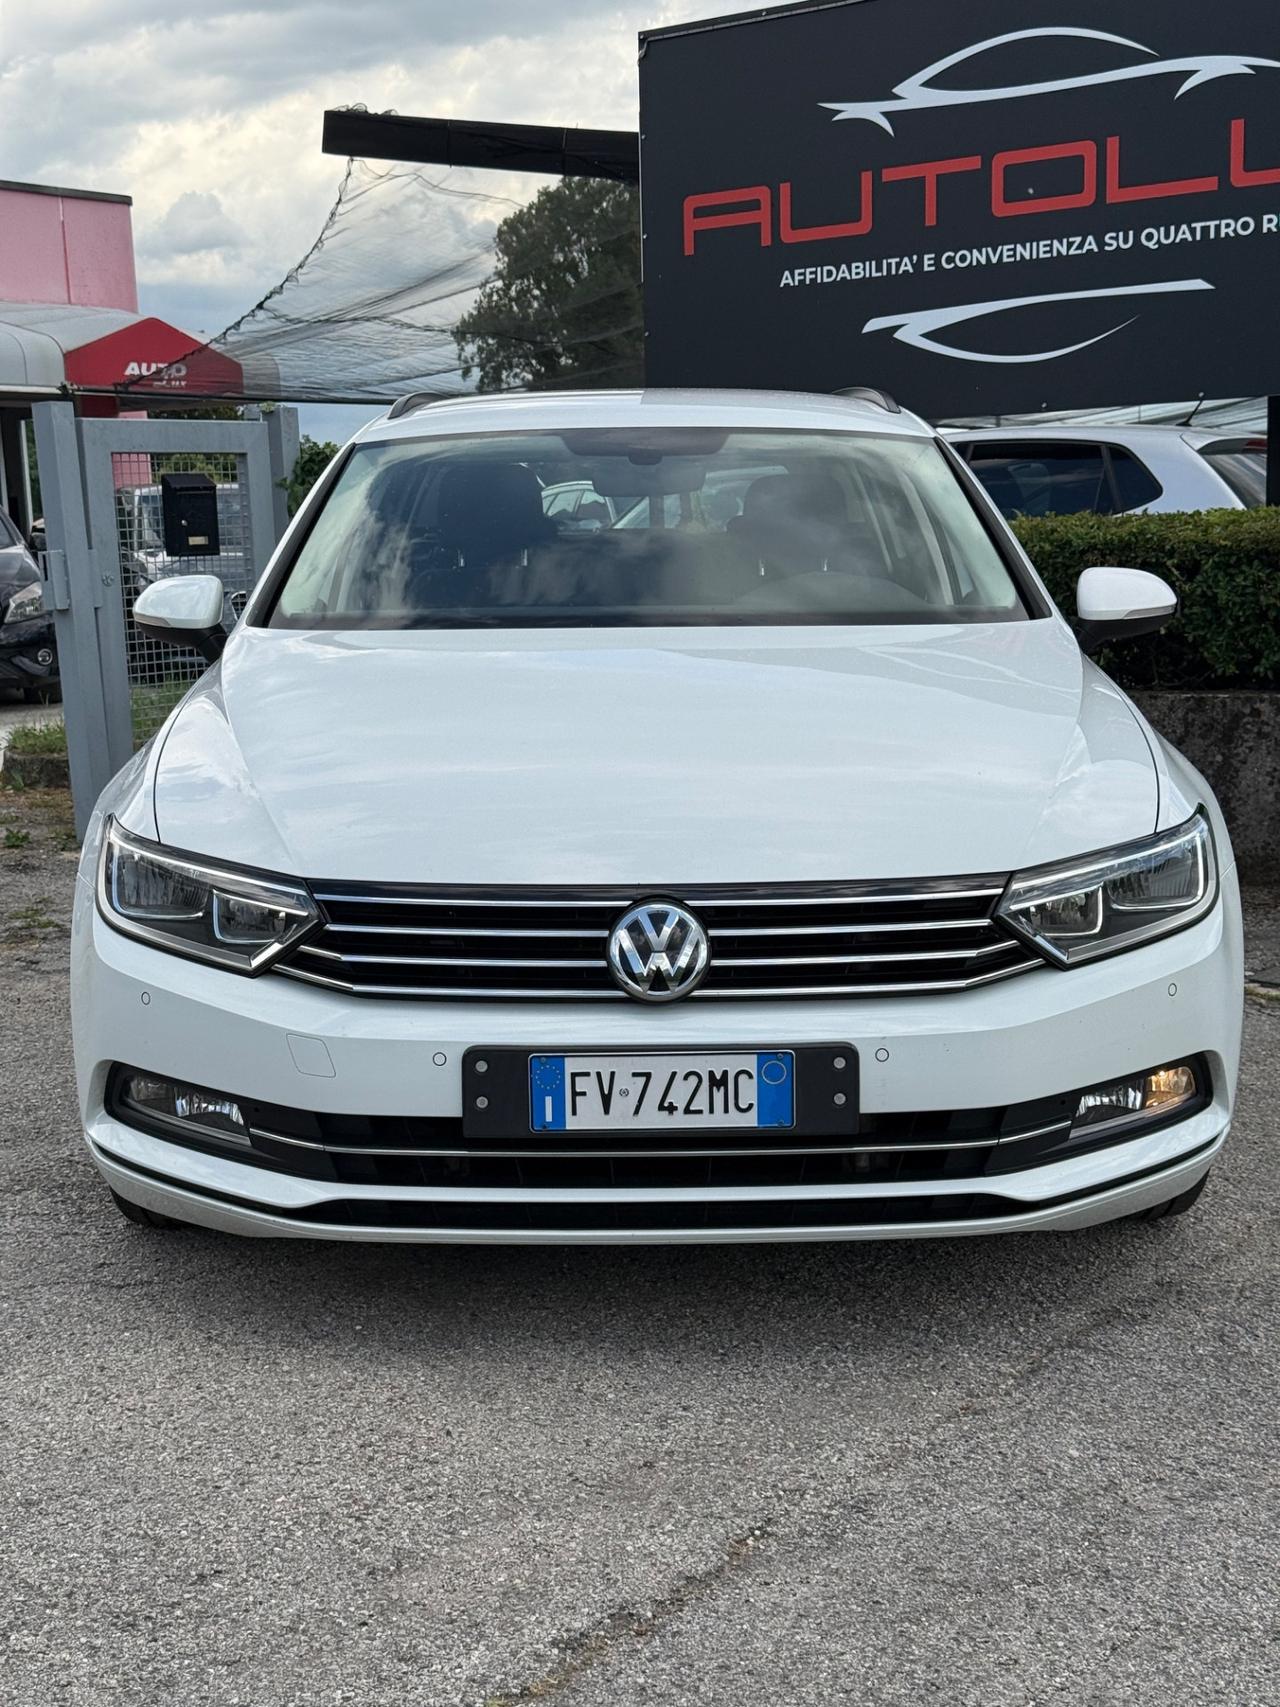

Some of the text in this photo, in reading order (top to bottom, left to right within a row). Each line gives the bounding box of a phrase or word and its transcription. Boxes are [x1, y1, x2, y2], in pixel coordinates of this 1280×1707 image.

[923, 253, 936, 272] E
[941, 234, 1099, 269] CONVENIENZA
[1104, 228, 1134, 251] SU
[1140, 216, 1255, 250] QUATTRO
[1262, 213, 1280, 234] R
